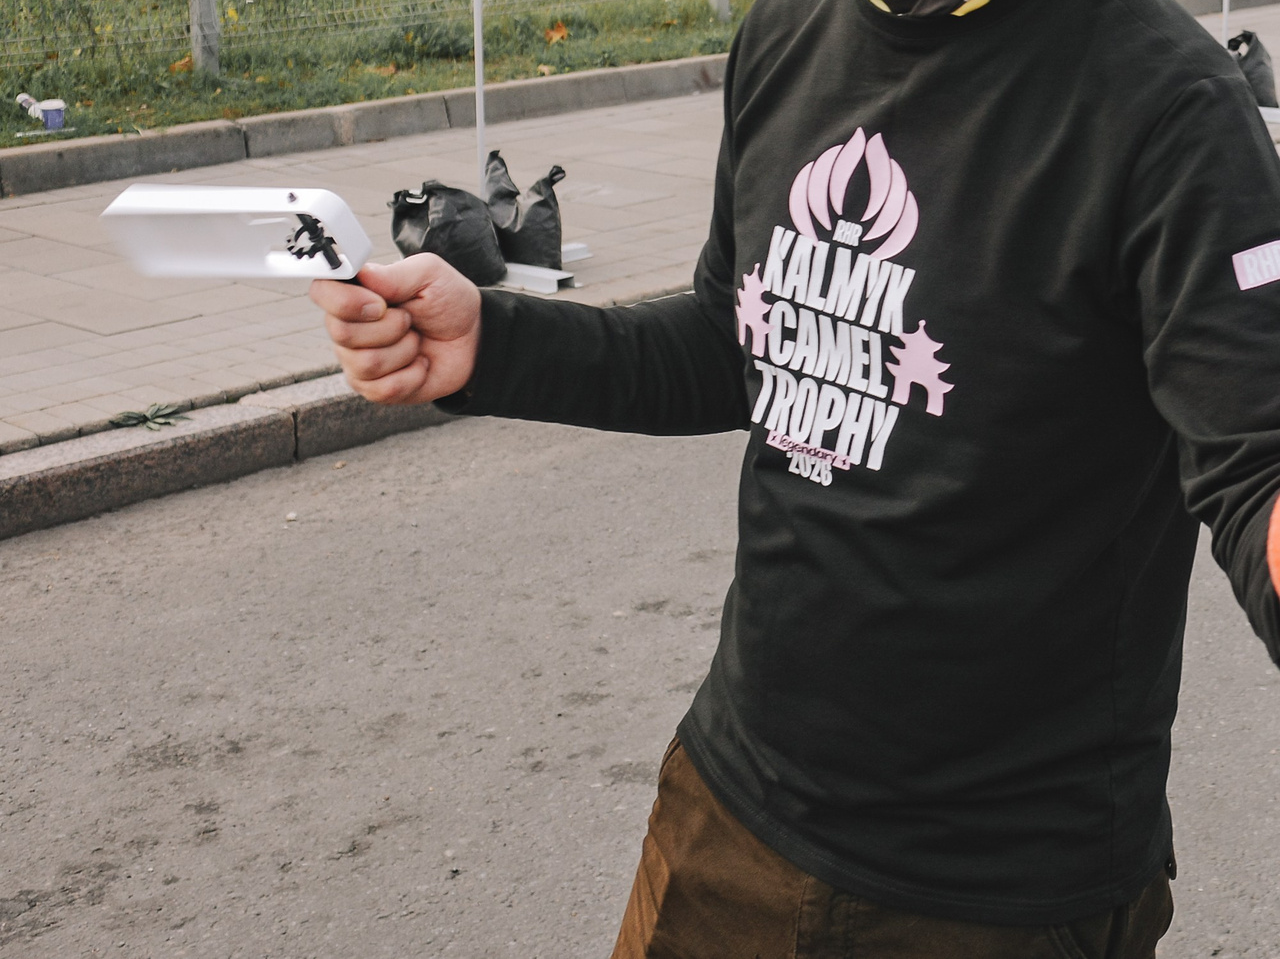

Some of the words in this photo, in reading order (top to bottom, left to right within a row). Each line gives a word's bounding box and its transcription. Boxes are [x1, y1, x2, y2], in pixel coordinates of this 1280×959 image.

[762, 225, 916, 337] KALMYK
[768, 300, 888, 399] CAMEL
[751, 359, 900, 471] TROPHY
[786, 451, 833, 487] 2026
